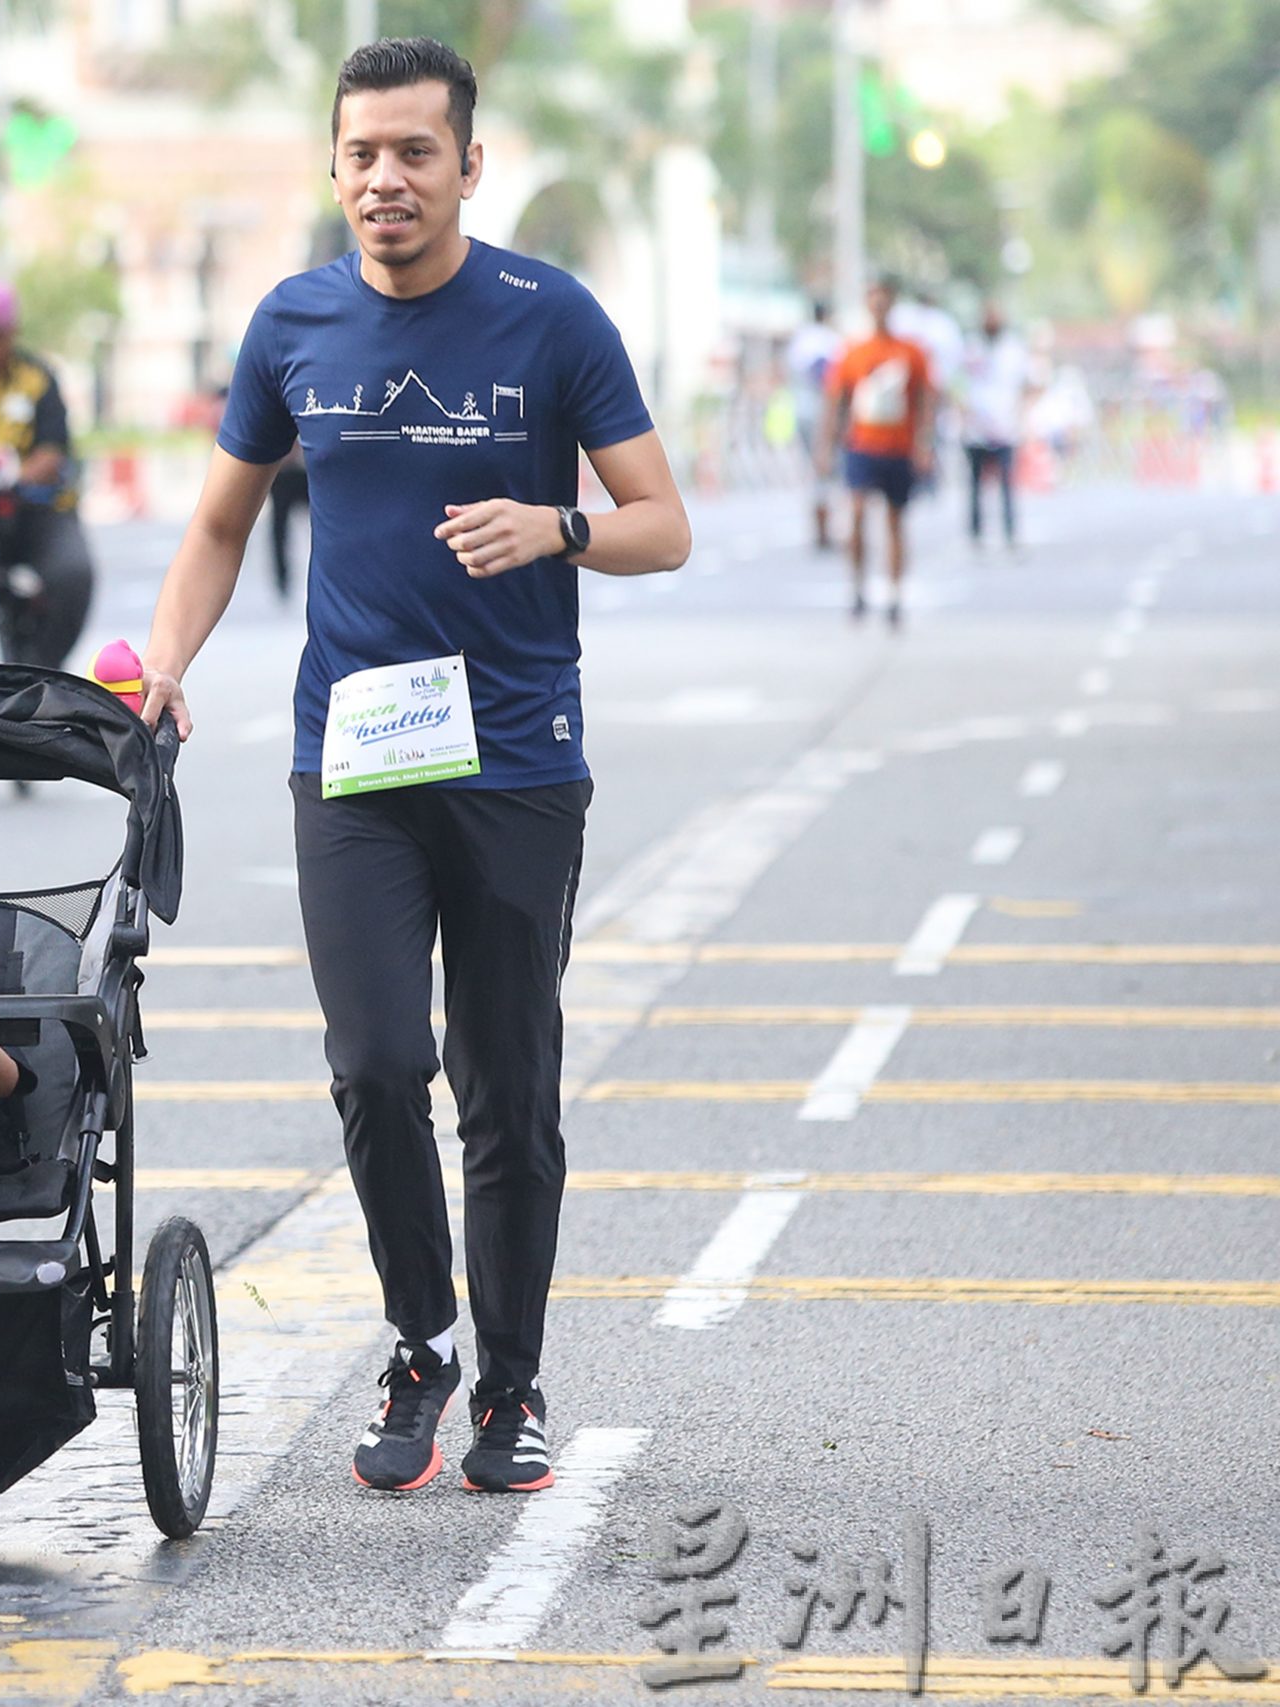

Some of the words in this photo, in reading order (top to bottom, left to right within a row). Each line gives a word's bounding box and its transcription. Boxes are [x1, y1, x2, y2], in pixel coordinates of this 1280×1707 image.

[499, 269, 538, 291] FITGEAR
[401, 425, 454, 436] MARATHON
[457, 426, 490, 437] BAKER
[410, 675, 431, 689] KL
[356, 704, 452, 740] healthy
[328, 760, 350, 773] 0441
